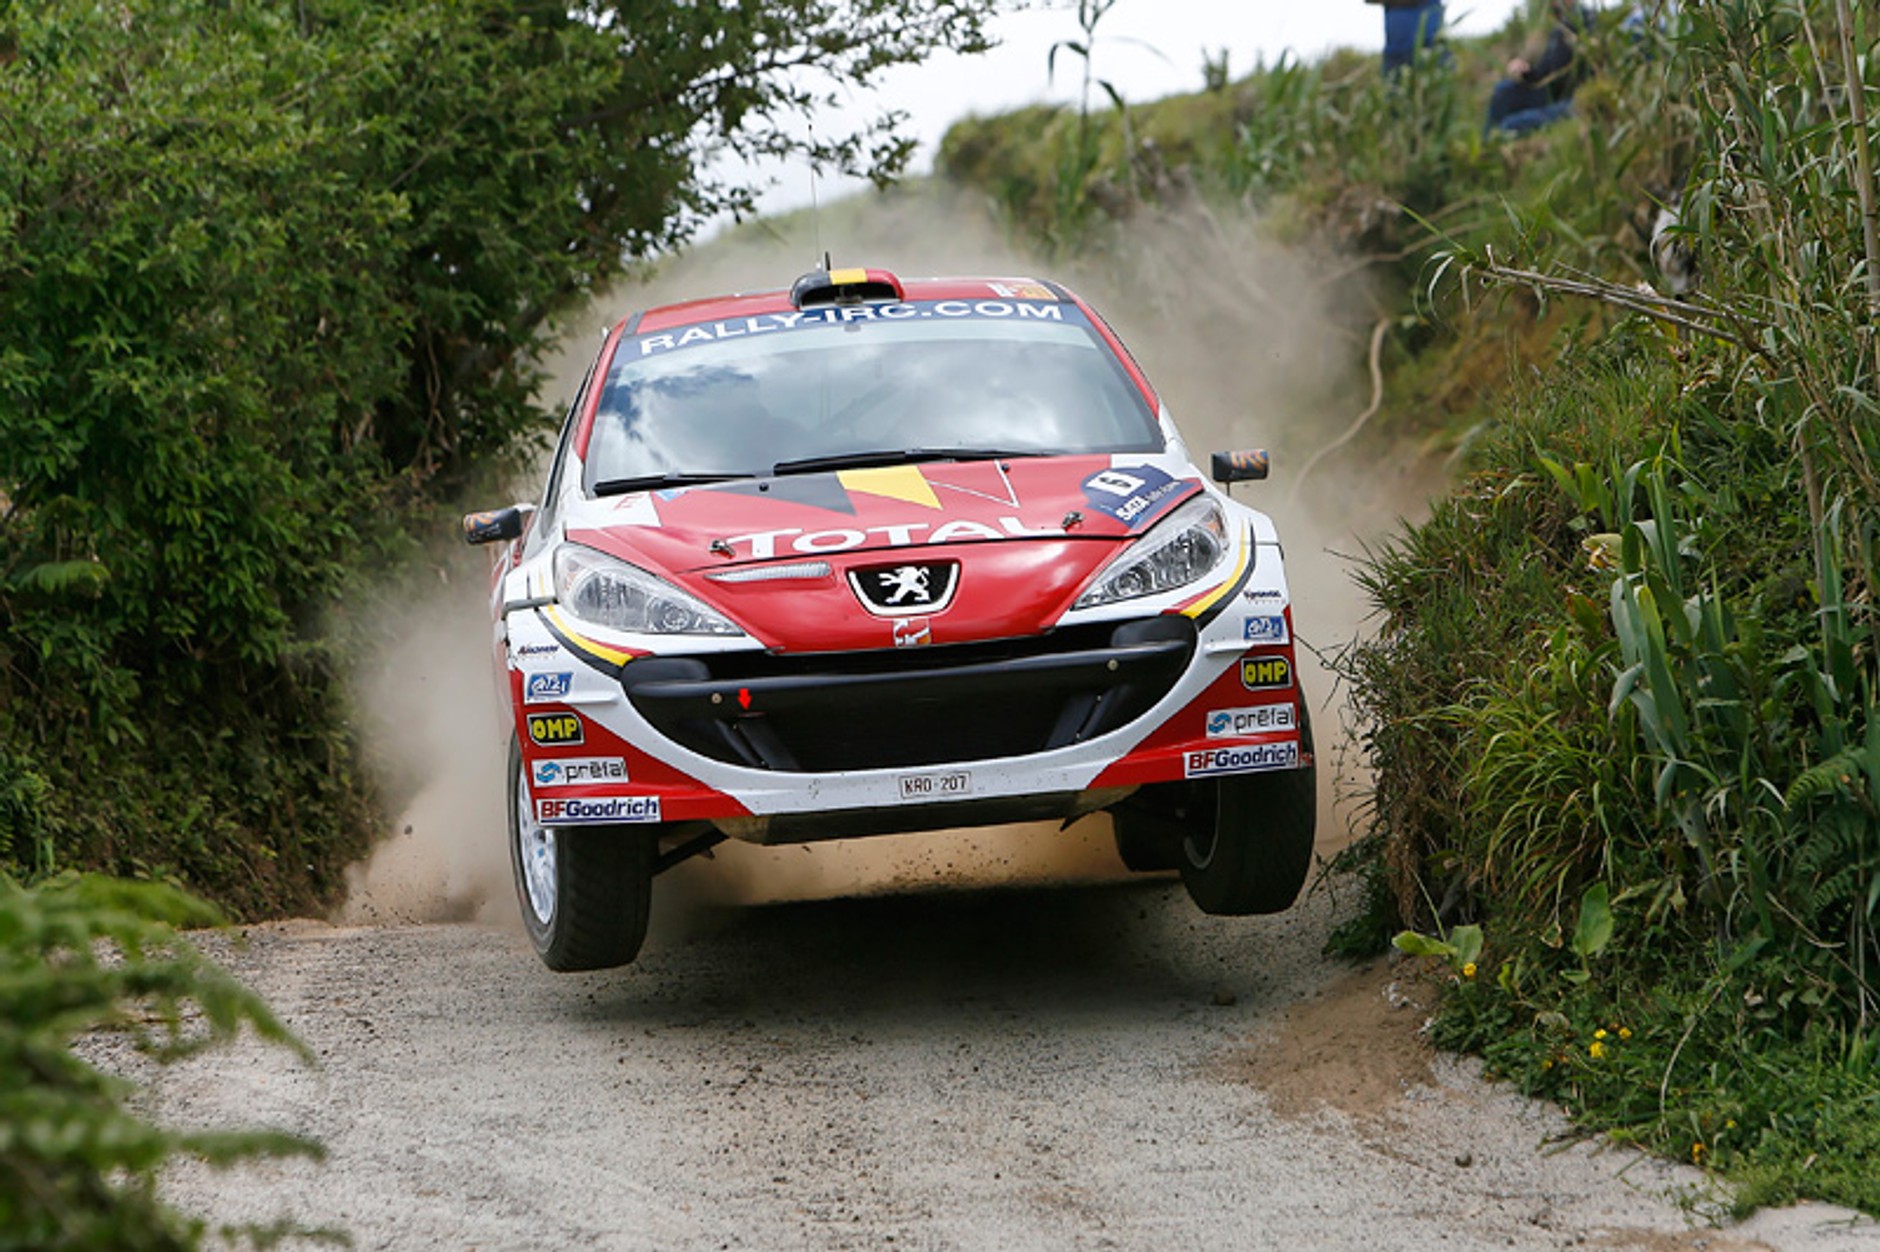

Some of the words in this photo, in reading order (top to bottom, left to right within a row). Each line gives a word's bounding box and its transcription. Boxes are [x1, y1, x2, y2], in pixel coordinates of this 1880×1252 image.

[640, 300, 1063, 356] RALLY-IRC.COM
[726, 516, 1069, 558] TOTAL
[1244, 661, 1288, 685] OMP
[531, 717, 578, 740] OMP
[1188, 743, 1297, 770] BFGoodrich
[940, 775, 967, 791] 207
[541, 798, 658, 818] BFGoodrich
